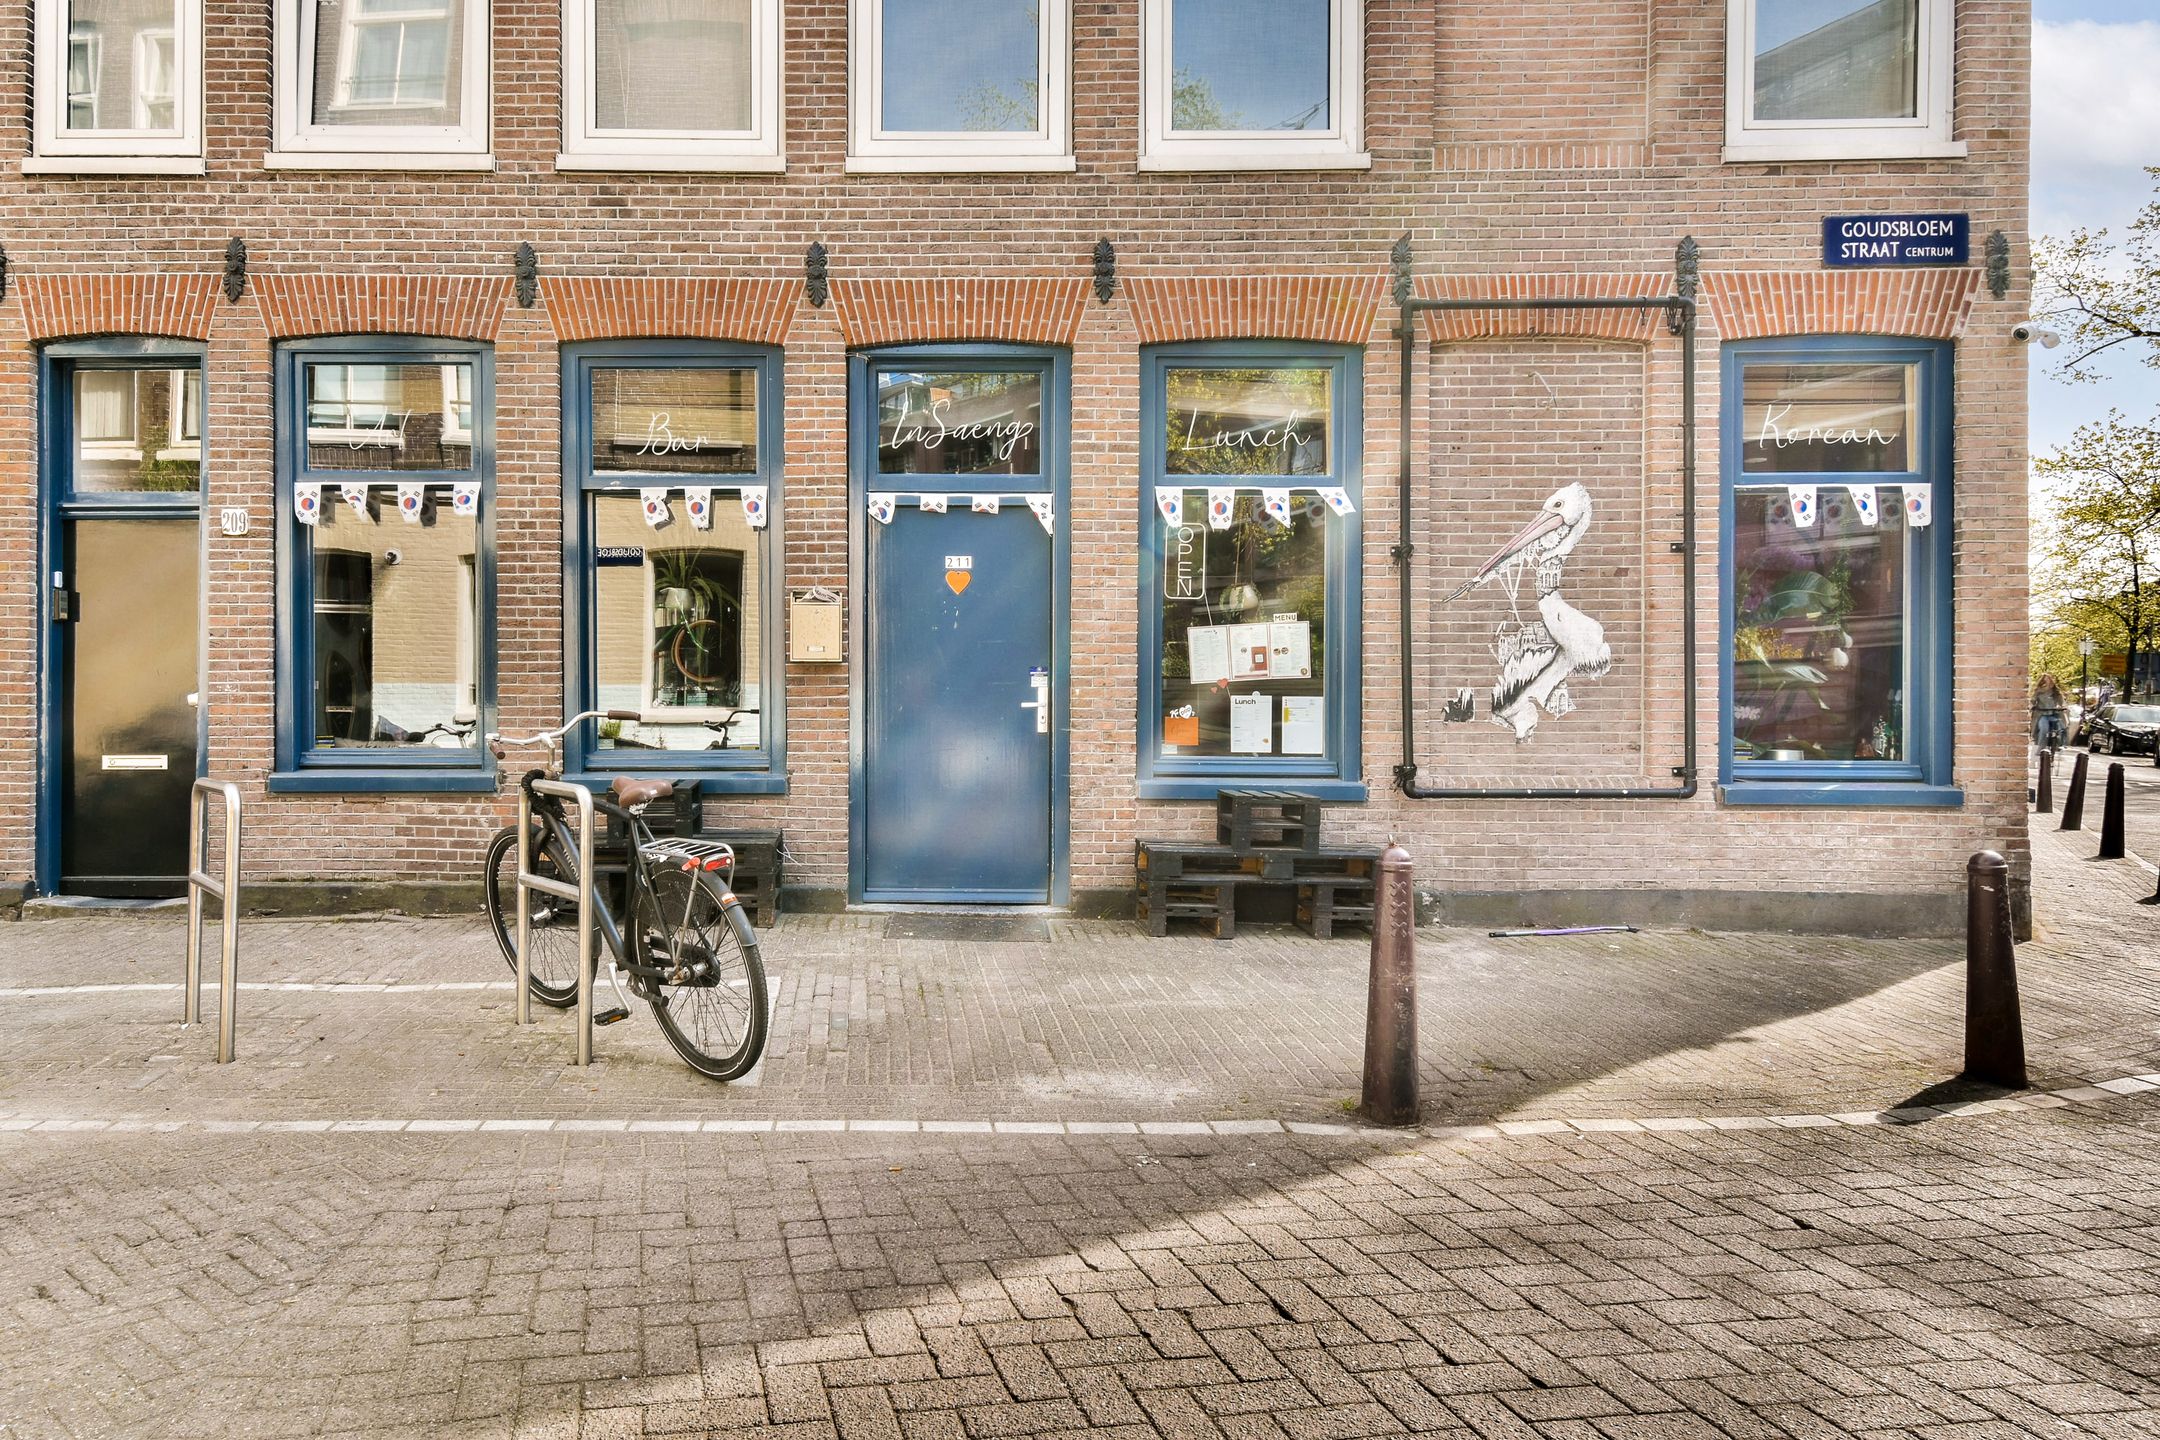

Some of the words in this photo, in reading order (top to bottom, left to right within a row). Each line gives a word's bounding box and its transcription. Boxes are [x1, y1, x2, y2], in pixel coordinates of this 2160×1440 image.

[1841, 220, 1954, 238] GOUDSBLOEM
[1841, 241, 1900, 258] STRAAT
[1905, 246, 1954, 257] CENTRUM
[636, 411, 709, 456] Bar
[891, 386, 1034, 461] InSaeng
[1181, 407, 1311, 452] Lunch
[1759, 404, 1897, 449] Korean
[222, 511, 246, 533] 209
[946, 557, 970, 568] 211
[1177, 526, 1194, 597] OPEN
